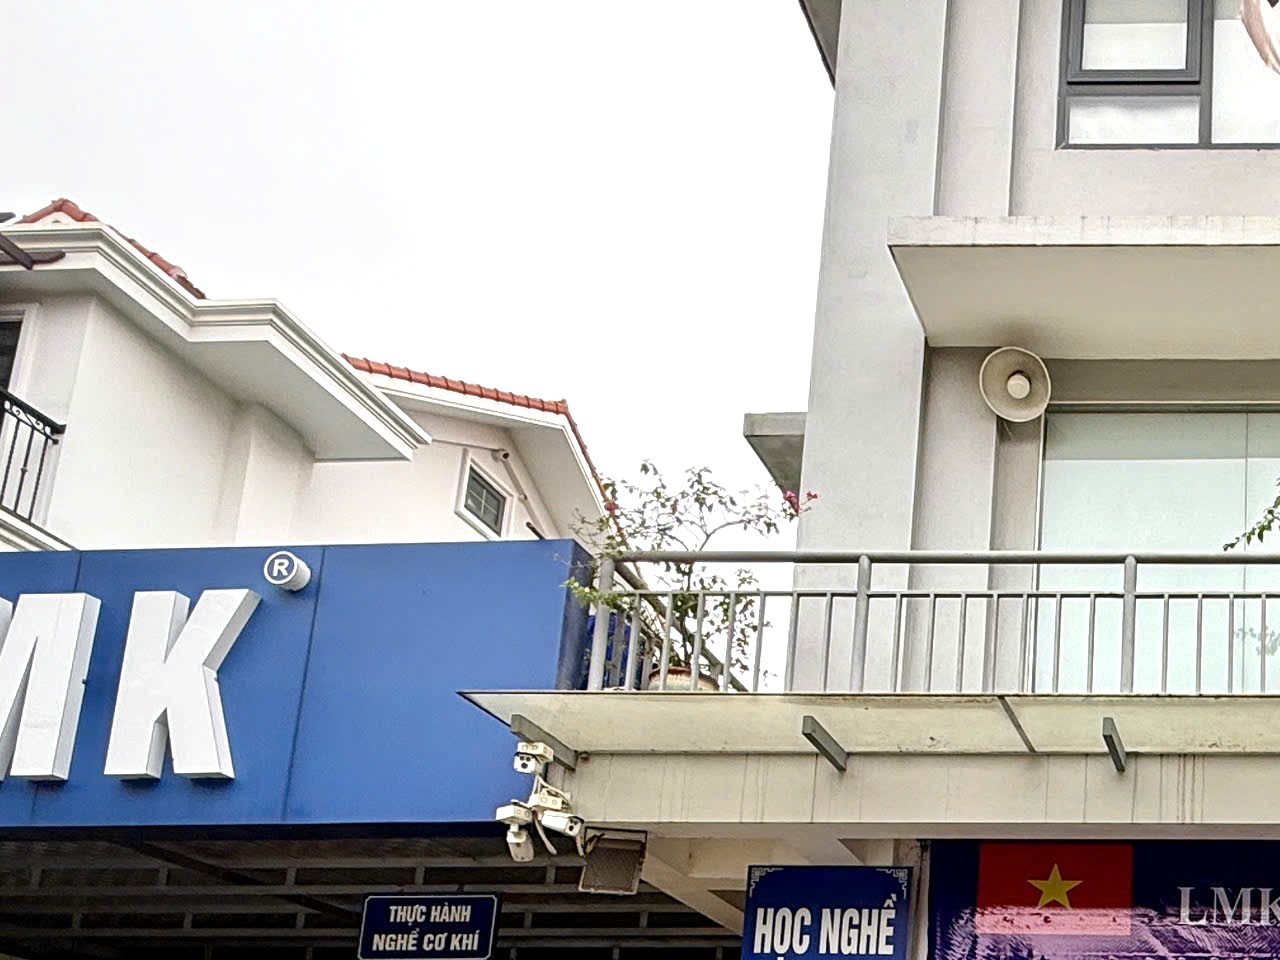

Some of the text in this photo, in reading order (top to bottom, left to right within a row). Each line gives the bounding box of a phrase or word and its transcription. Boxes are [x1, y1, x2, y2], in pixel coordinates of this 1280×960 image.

[389, 902, 472, 926] THỰC HÀNH
[819, 893, 897, 955] NGHỀ
[372, 927, 480, 951] NGHỀ CƠ KHÍ
